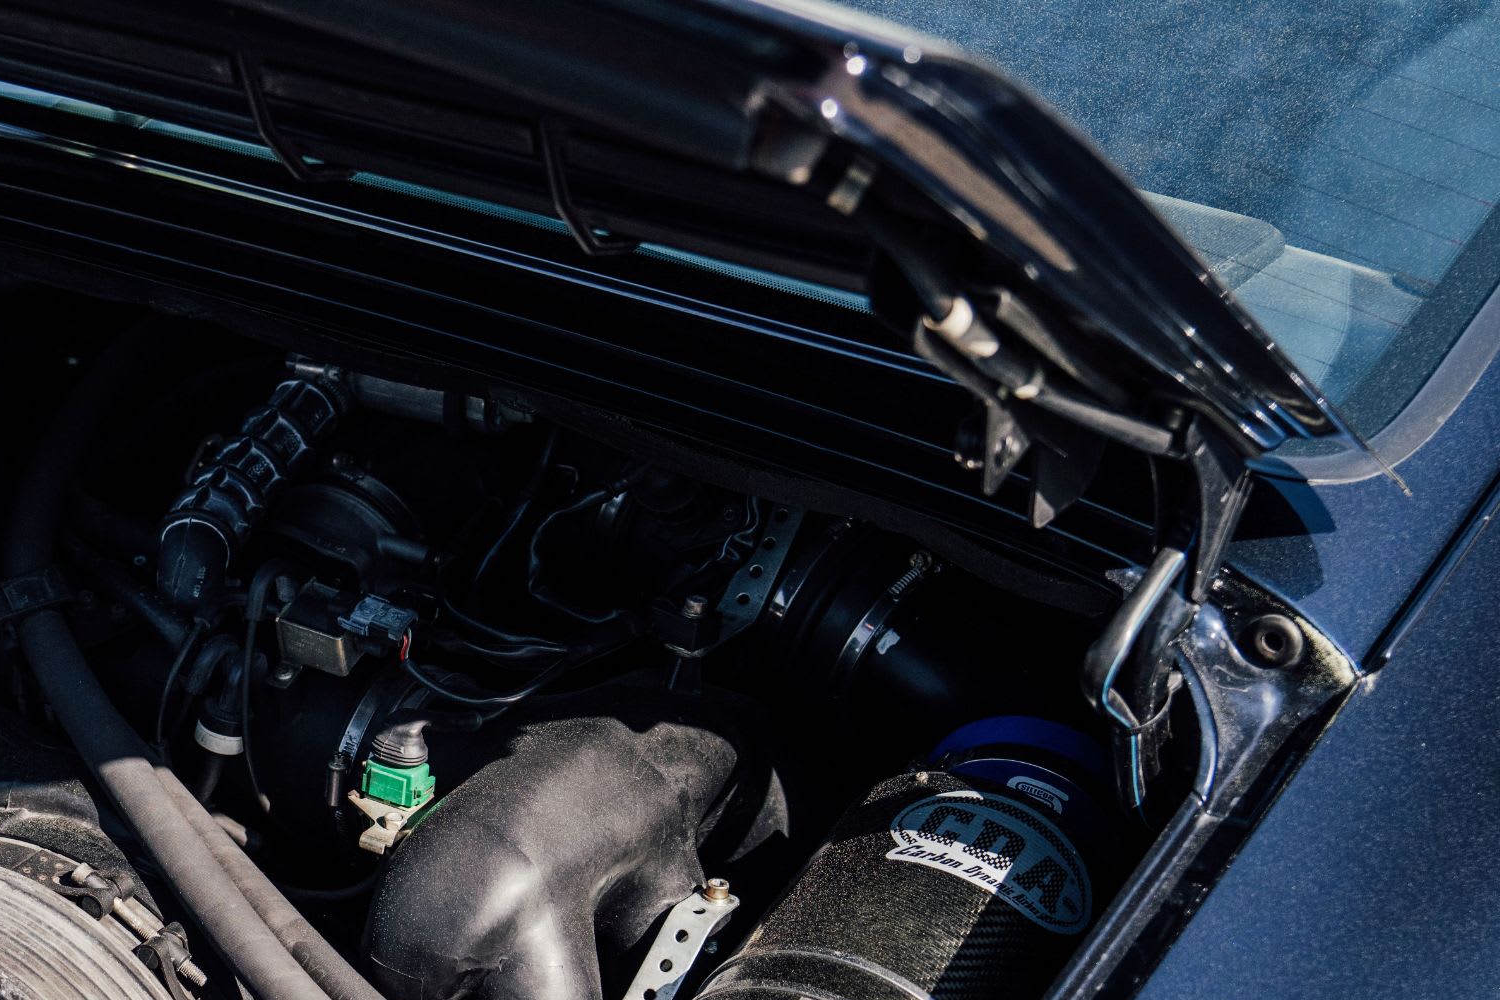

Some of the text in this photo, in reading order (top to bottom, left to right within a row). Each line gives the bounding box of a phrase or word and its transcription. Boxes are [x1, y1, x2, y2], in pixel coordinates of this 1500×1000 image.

[895, 843, 963, 869] Carbon
[963, 864, 1015, 897] Dynamic
[917, 805, 1068, 915] CDA
